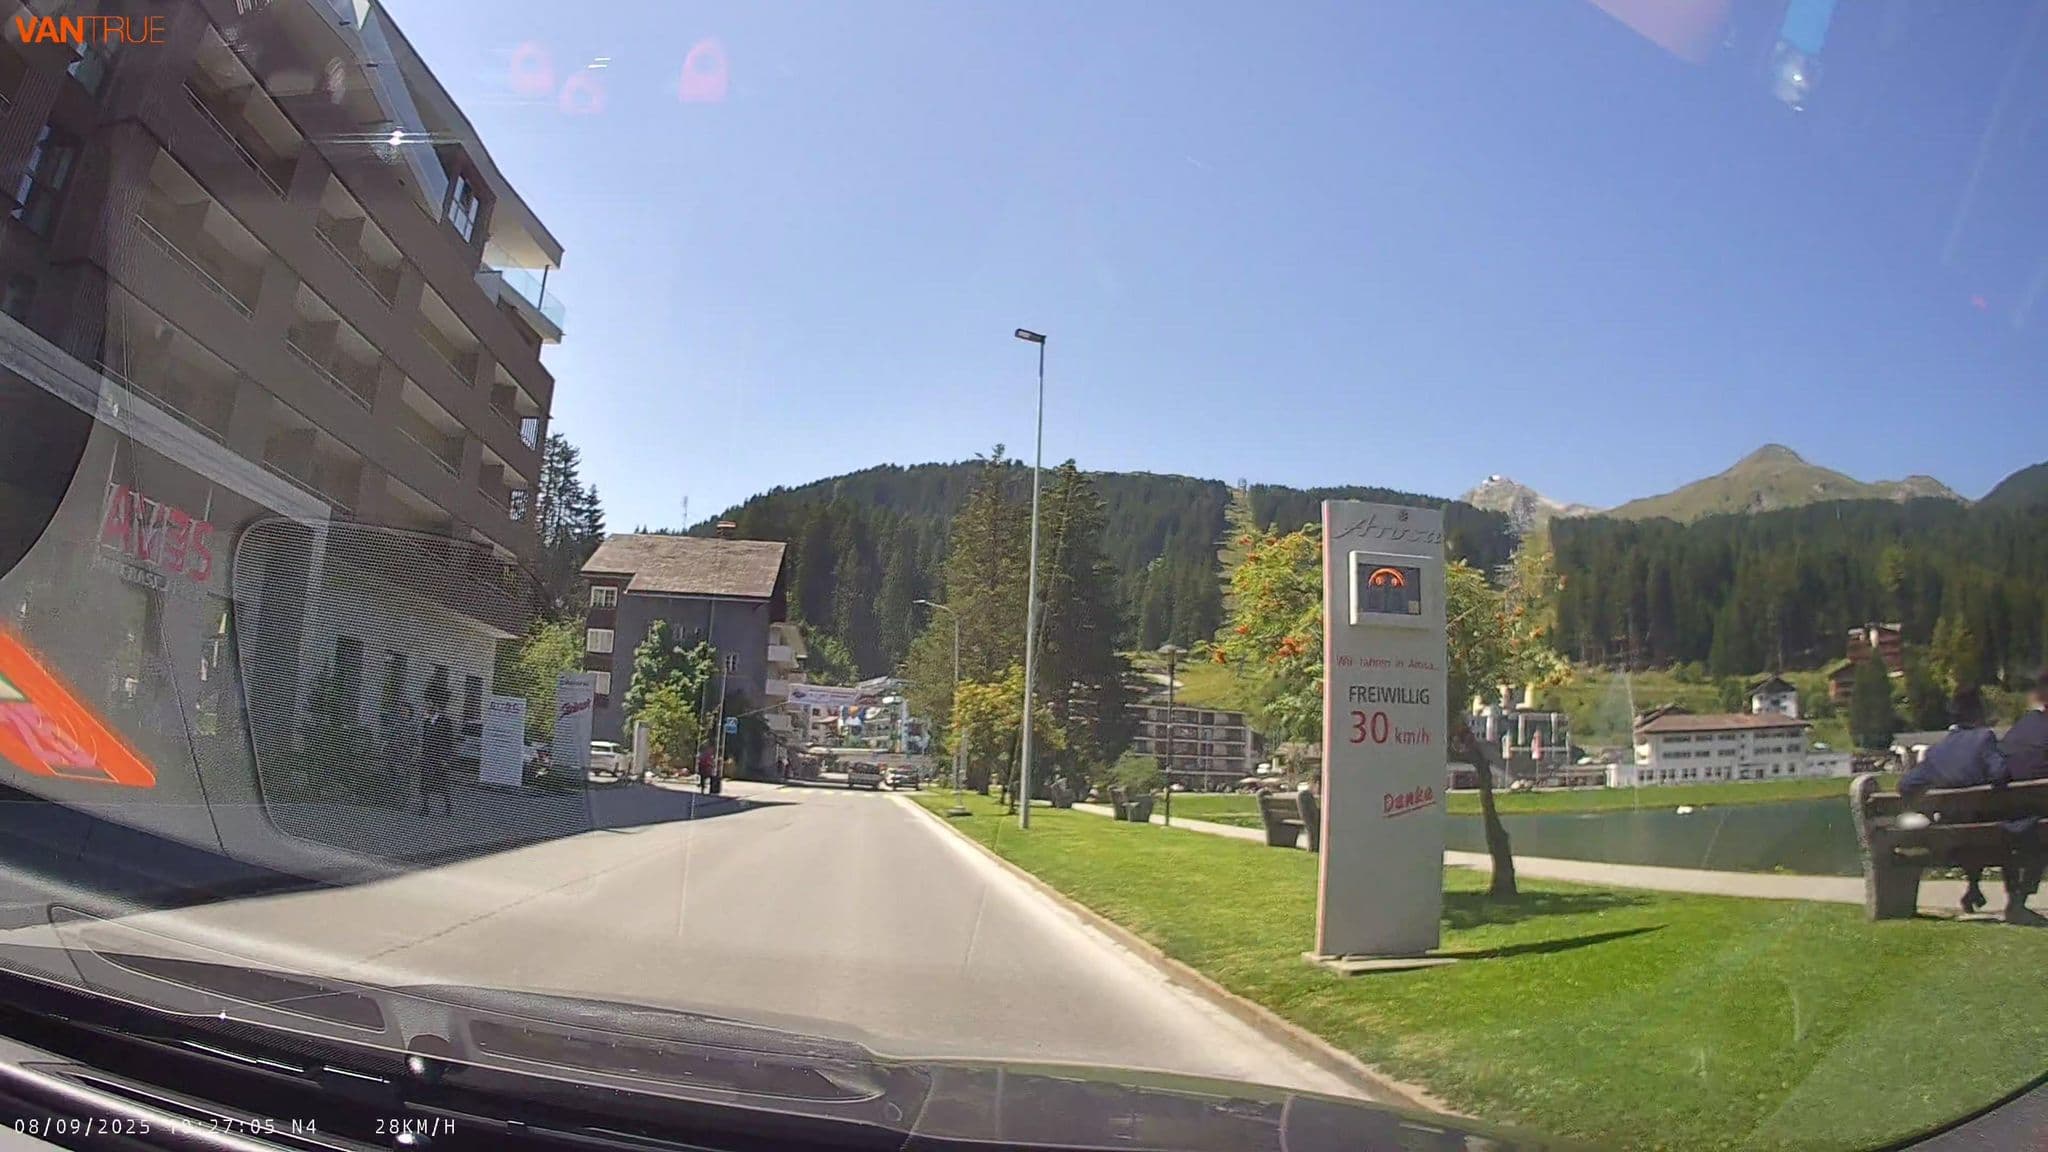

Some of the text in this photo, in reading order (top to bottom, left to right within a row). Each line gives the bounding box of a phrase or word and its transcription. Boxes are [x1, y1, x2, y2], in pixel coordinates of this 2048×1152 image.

[1348, 685, 1431, 705] FREIWILLIG
[1349, 710, 1431, 745] 30 km/h
[1383, 785, 1434, 815] Danke
